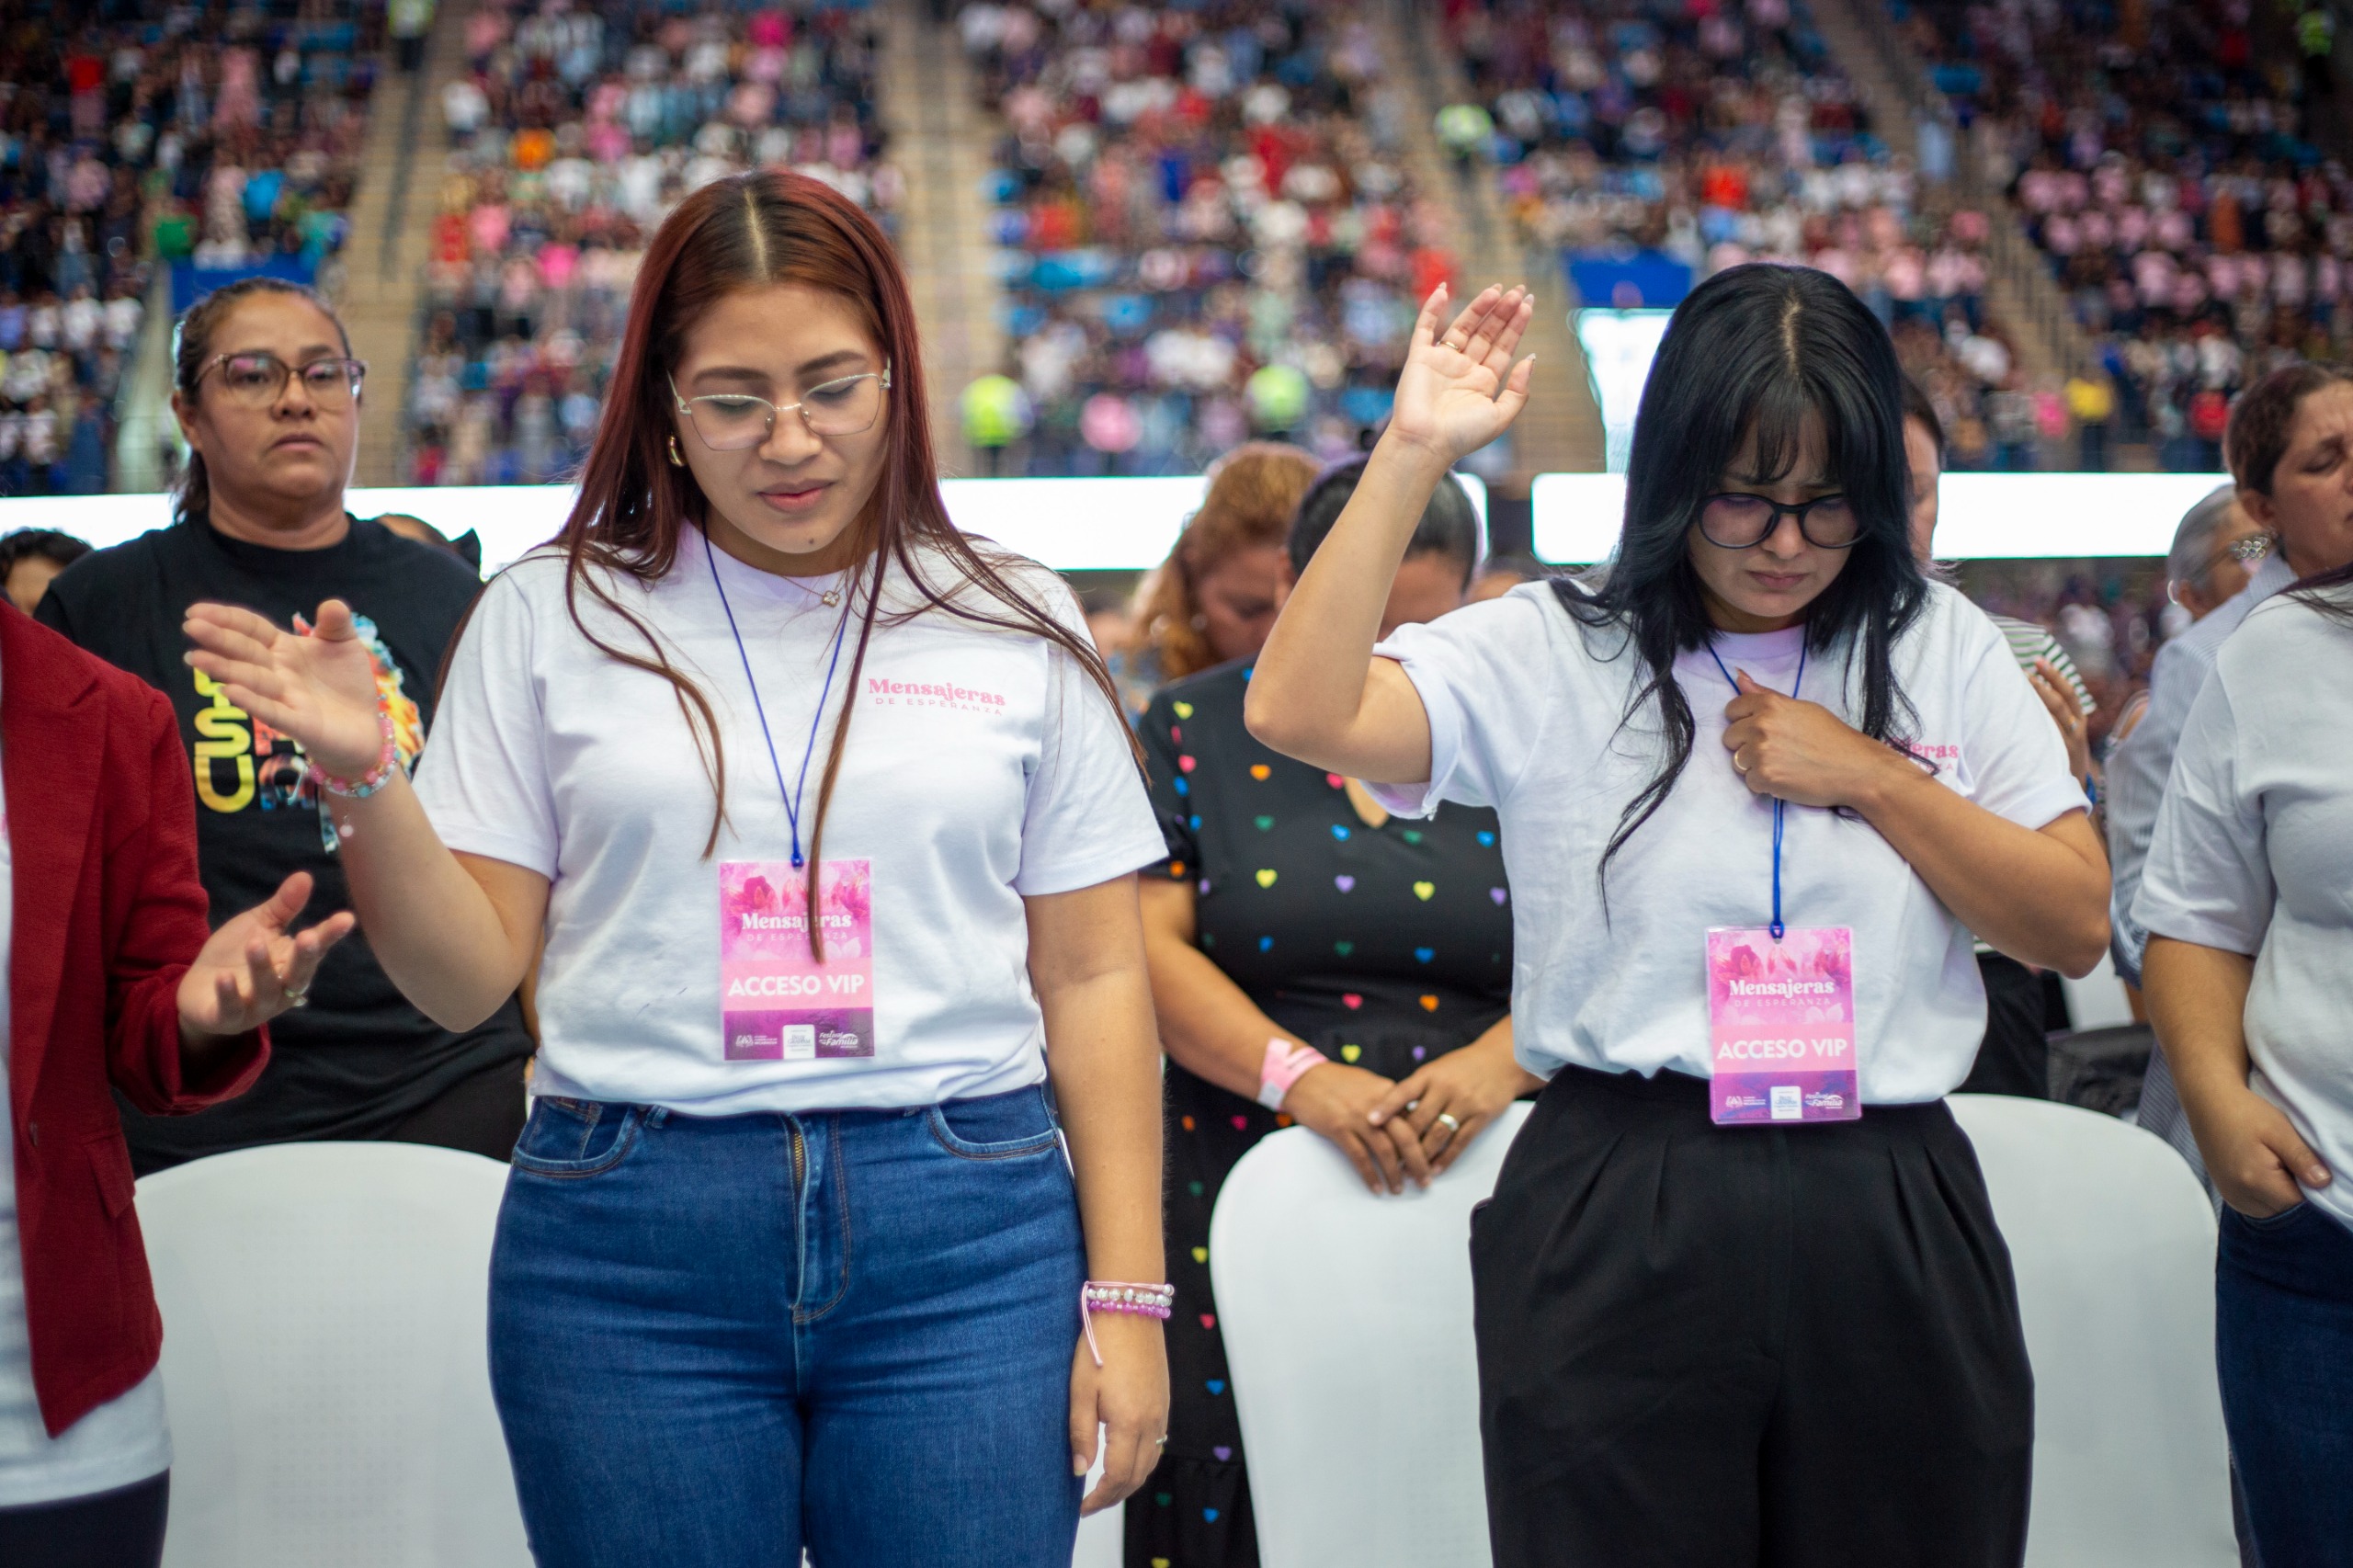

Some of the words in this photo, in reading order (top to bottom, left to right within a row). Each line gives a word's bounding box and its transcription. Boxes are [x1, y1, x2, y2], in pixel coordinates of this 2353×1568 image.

[869, 678, 1006, 706] Mensajeras
[907, 698, 1002, 716] ESPERANZA
[742, 913, 852, 933] Mensajras
[747, 933, 763, 942] DE
[728, 975, 821, 997] ACCESO
[826, 974, 865, 994] VIP
[1729, 979, 1835, 999] Mensajeras
[1734, 999, 1750, 1007] DE
[1757, 997, 1831, 1006] ESPERANZA
[1717, 1040, 1806, 1060] ACCESO
[1811, 1039, 1847, 1057] VIP
